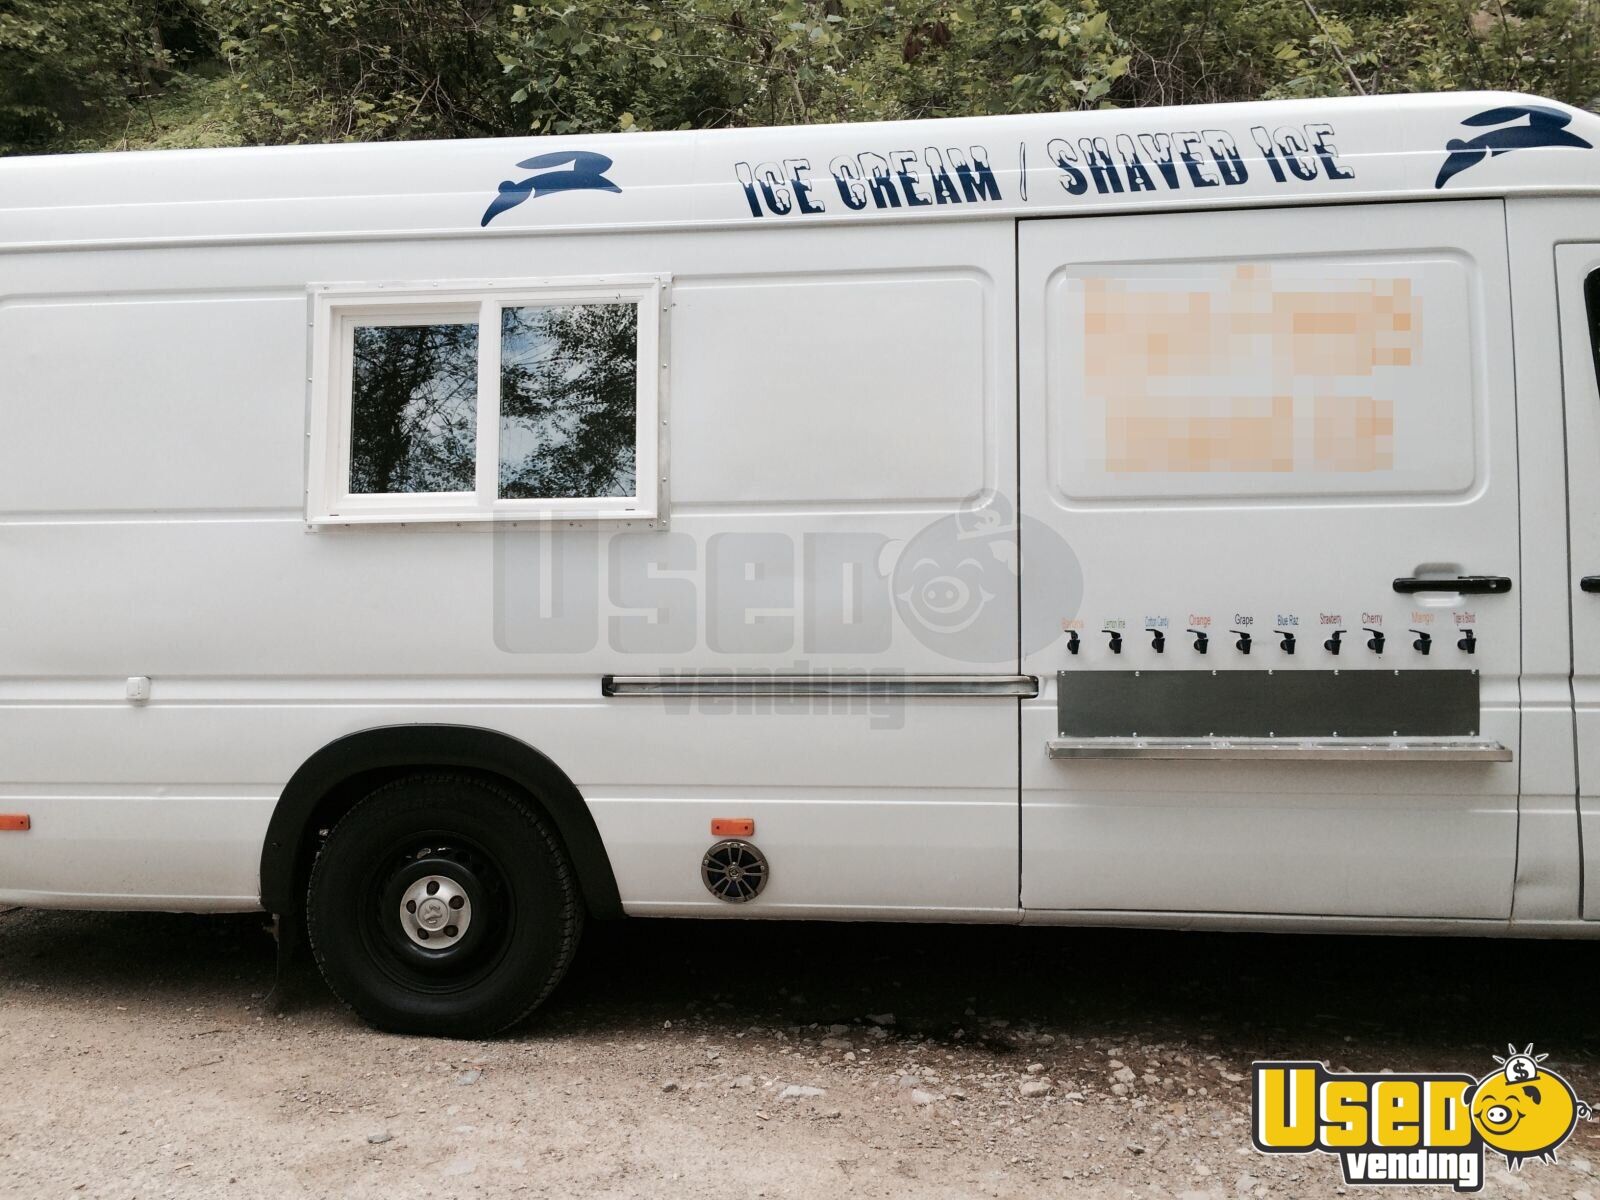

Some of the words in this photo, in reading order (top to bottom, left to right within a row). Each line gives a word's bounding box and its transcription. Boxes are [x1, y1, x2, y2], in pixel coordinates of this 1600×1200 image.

[735, 158, 826, 218] ICE
[829, 146, 1003, 211] CREAM
[1046, 129, 1249, 196] SHAVED
[1250, 122, 1356, 183] ICE
[1189, 614, 1211, 628] Orange
[1234, 613, 1254, 628] Grape
[1277, 614, 1288, 626] Blue
[1289, 614, 1299, 626] Raz
[1362, 612, 1383, 626] Cherry
[1411, 611, 1435, 625] Mango
